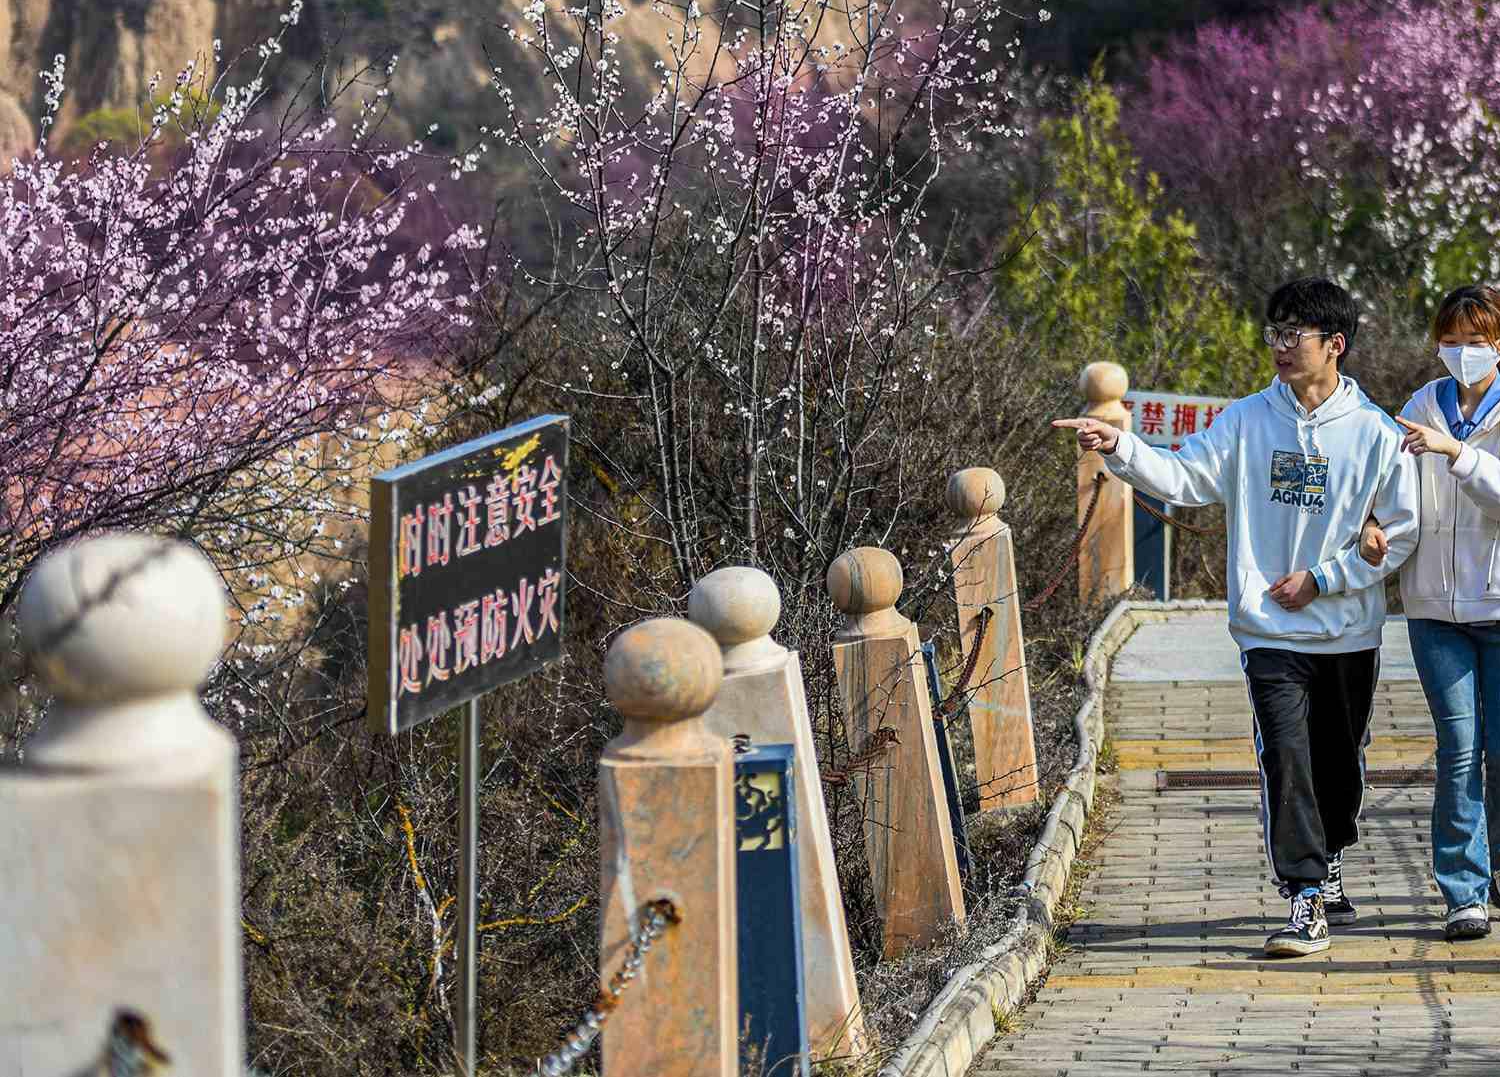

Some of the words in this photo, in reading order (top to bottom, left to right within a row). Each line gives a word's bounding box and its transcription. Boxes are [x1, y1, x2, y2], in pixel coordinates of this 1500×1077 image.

[399, 455, 562, 577] 时时注意安全
[398, 568, 561, 698] 处处预防火灾
